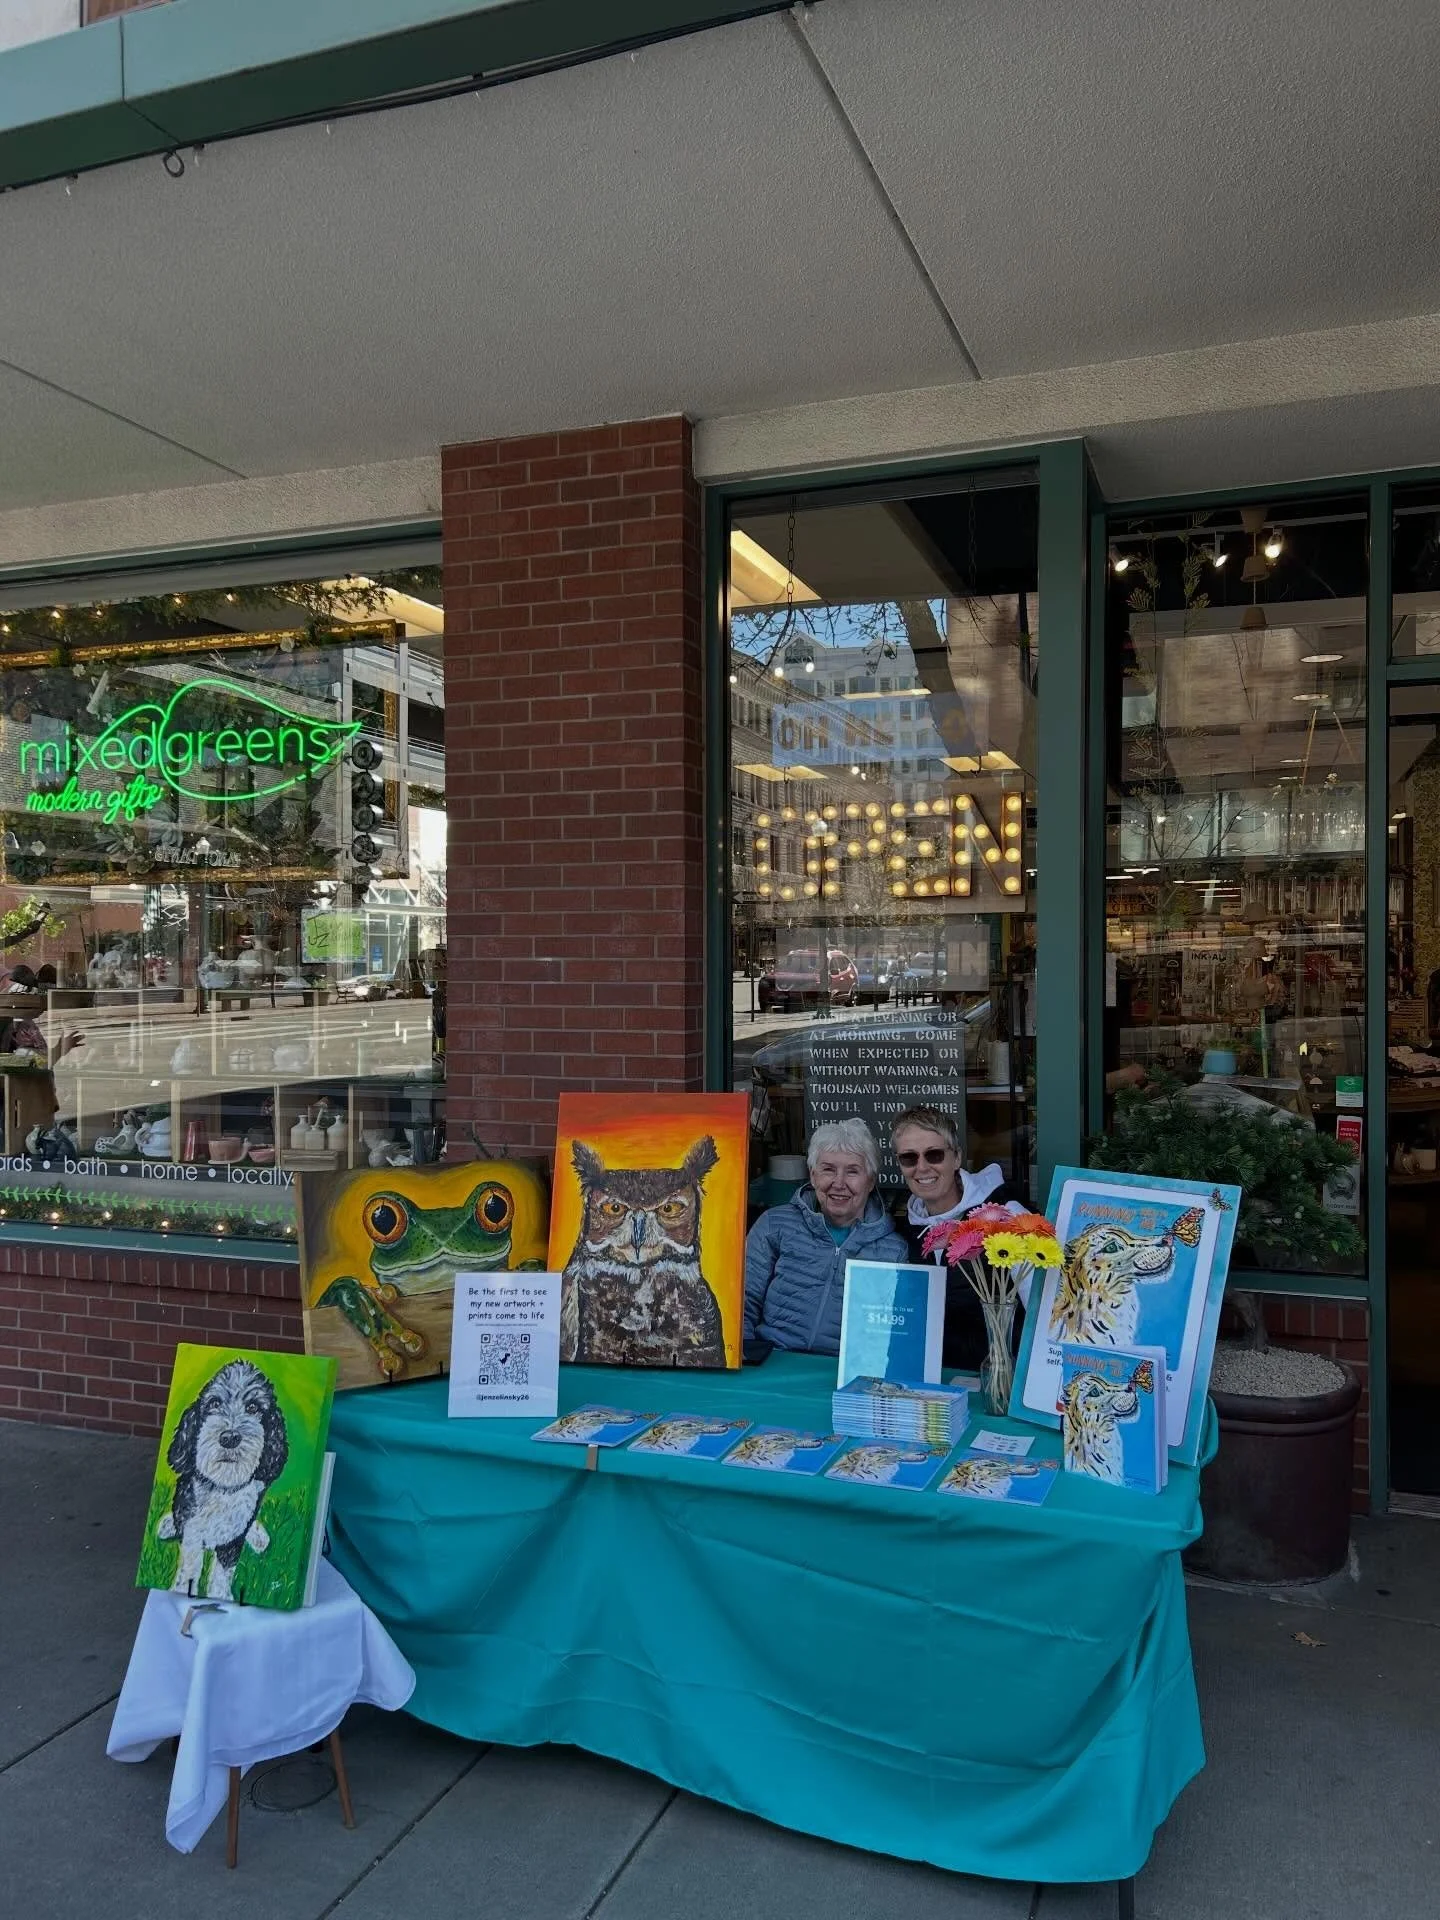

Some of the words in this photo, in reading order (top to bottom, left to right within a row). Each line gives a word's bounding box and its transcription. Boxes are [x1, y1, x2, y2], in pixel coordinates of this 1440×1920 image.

[20, 722, 157, 776] mixed
[165, 727, 332, 777] greens
[26, 777, 103, 812] modern
[102, 776, 163, 825] gifts
[938, 1011, 957, 1022] OR
[808, 1030, 826, 1041] AT
[835, 1030, 906, 1041] MORNING.
[915, 1030, 957, 1041] COME
[809, 1048, 849, 1059] WHEN
[858, 1048, 929, 1059] EXPECTED
[939, 1048, 959, 1059] OR
[809, 1065, 870, 1076] WITHOUT
[874, 1065, 944, 1076] WARNING.
[949, 1066, 958, 1076] A
[810, 1084, 881, 1095] THOUSAND
[885, 1084, 960, 1095] WELCOMES
[811, 1102, 861, 1113] YOU'LL
[874, 1102, 906, 1113] FIND
[64, 1156, 108, 1176] bath
[141, 1162, 198, 1181] home
[227, 1164, 294, 1190] locally
[468, 1287, 479, 1296] Be
[482, 1287, 496, 1295] the
[500, 1287, 518, 1296] first
[522, 1288, 531, 1296] to
[470, 1301, 482, 1310] my
[503, 1299, 536, 1308] artwork
[468, 1311, 492, 1321] prints
[531, 1311, 545, 1320] life
